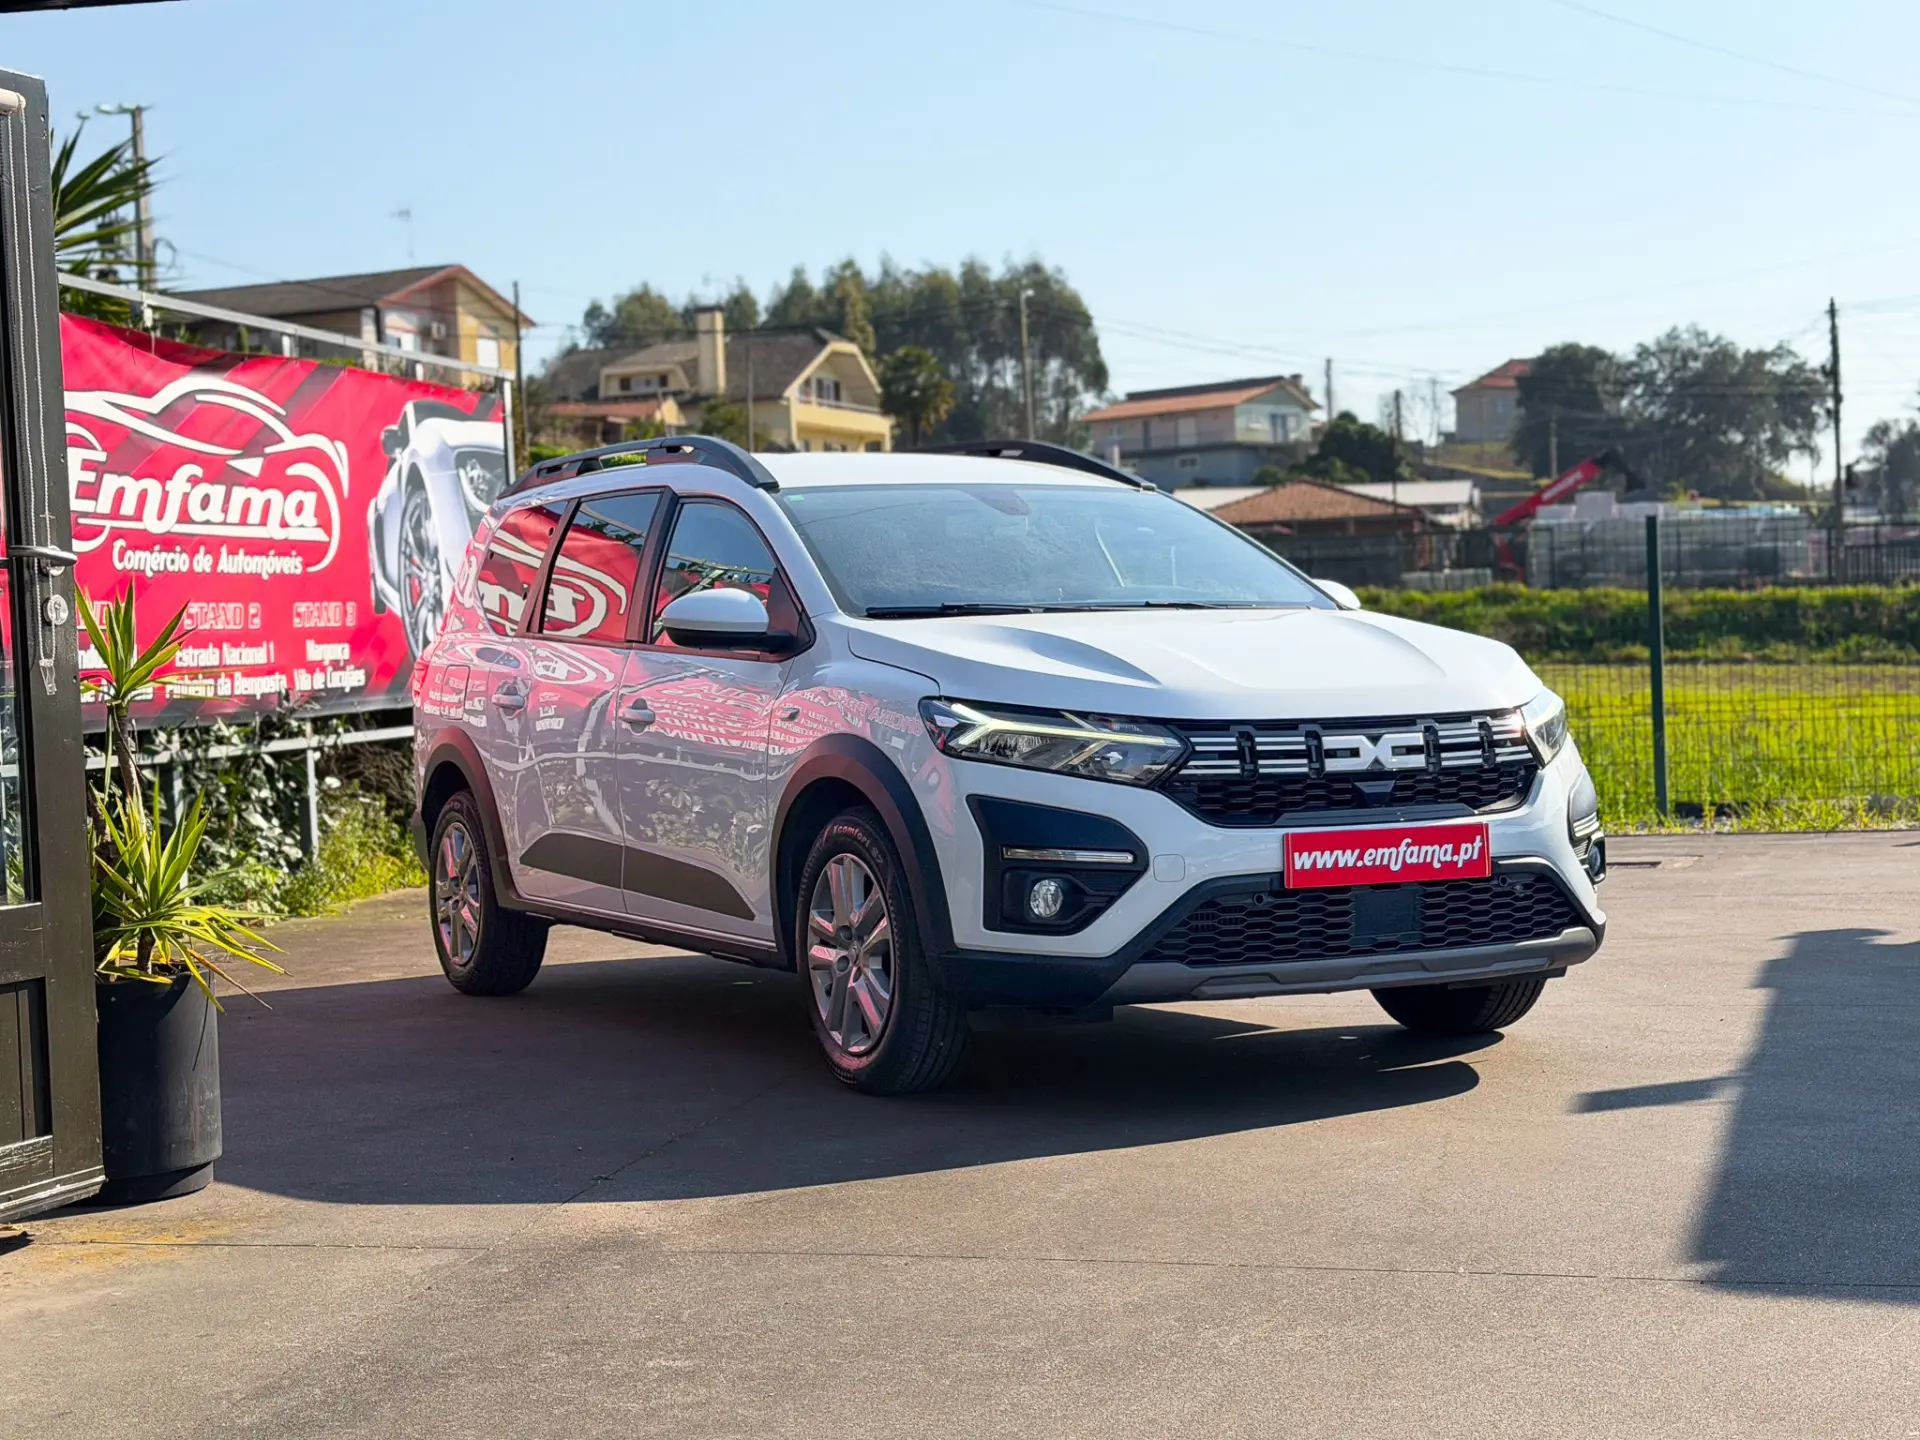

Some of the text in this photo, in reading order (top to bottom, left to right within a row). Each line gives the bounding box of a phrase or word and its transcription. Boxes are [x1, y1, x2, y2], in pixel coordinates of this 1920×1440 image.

[67, 446, 318, 540] Emfama
[112, 538, 304, 580] Comércio de Automóveis
[184, 602, 261, 630] STAND 2
[293, 602, 357, 628] STAND 3
[222, 641, 267, 665] Nacional
[217, 672, 232, 696] da
[293, 669, 312, 690] Vila
[313, 668, 325, 690] de
[1293, 835, 1483, 871] www.emfama.pt
